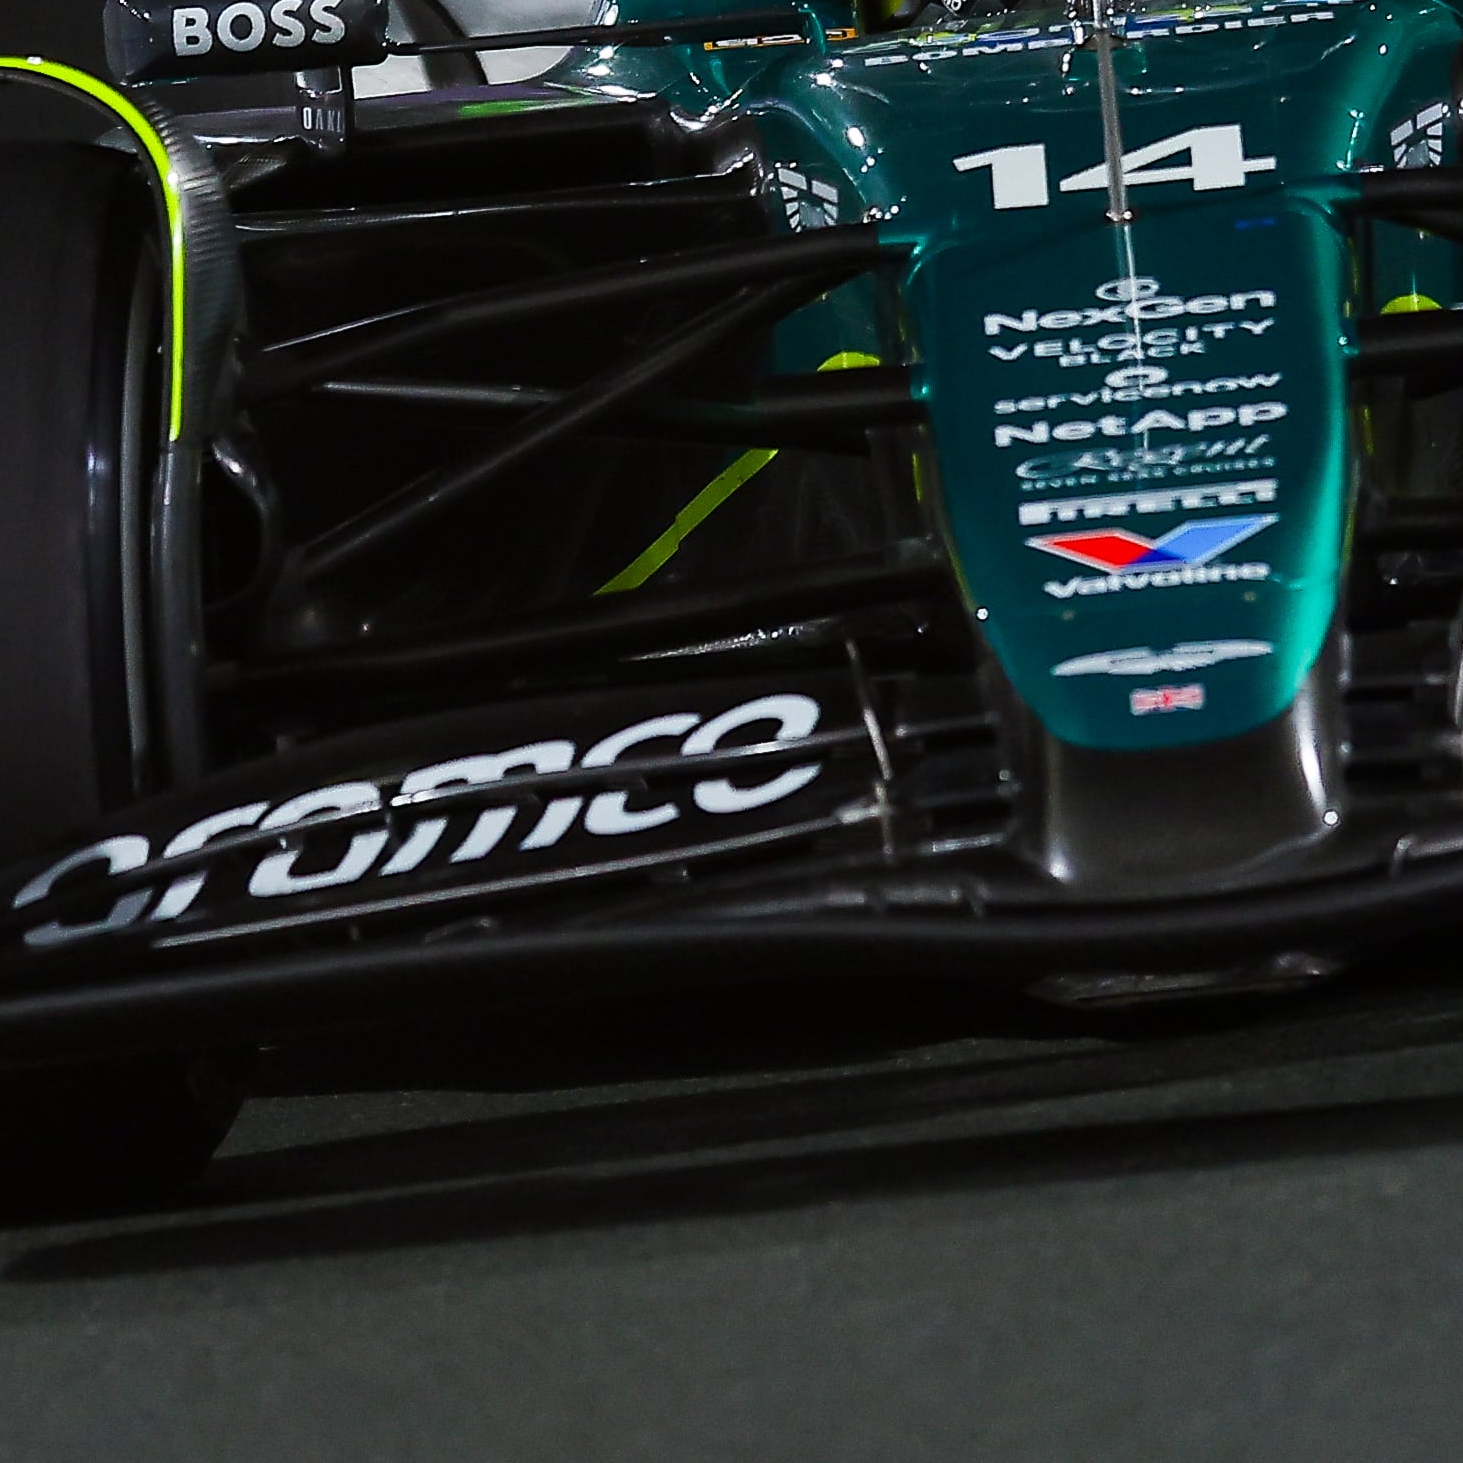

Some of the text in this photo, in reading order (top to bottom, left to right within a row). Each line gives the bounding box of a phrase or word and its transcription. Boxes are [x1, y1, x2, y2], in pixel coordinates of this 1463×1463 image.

[864, 11, 1335, 68] BOMBRDIER
[302, 106, 344, 133] OAKL
[953, 123, 1277, 210] 14
[983, 289, 1277, 336] NexGen
[987, 316, 1276, 362] VELOCITY
[1058, 340, 1207, 368] BLACK
[993, 371, 1284, 415] servicenow
[994, 400, 1290, 448] NetApp
[1042, 561, 1272, 600] Valvoline
[11, 693, 821, 949] aramco
